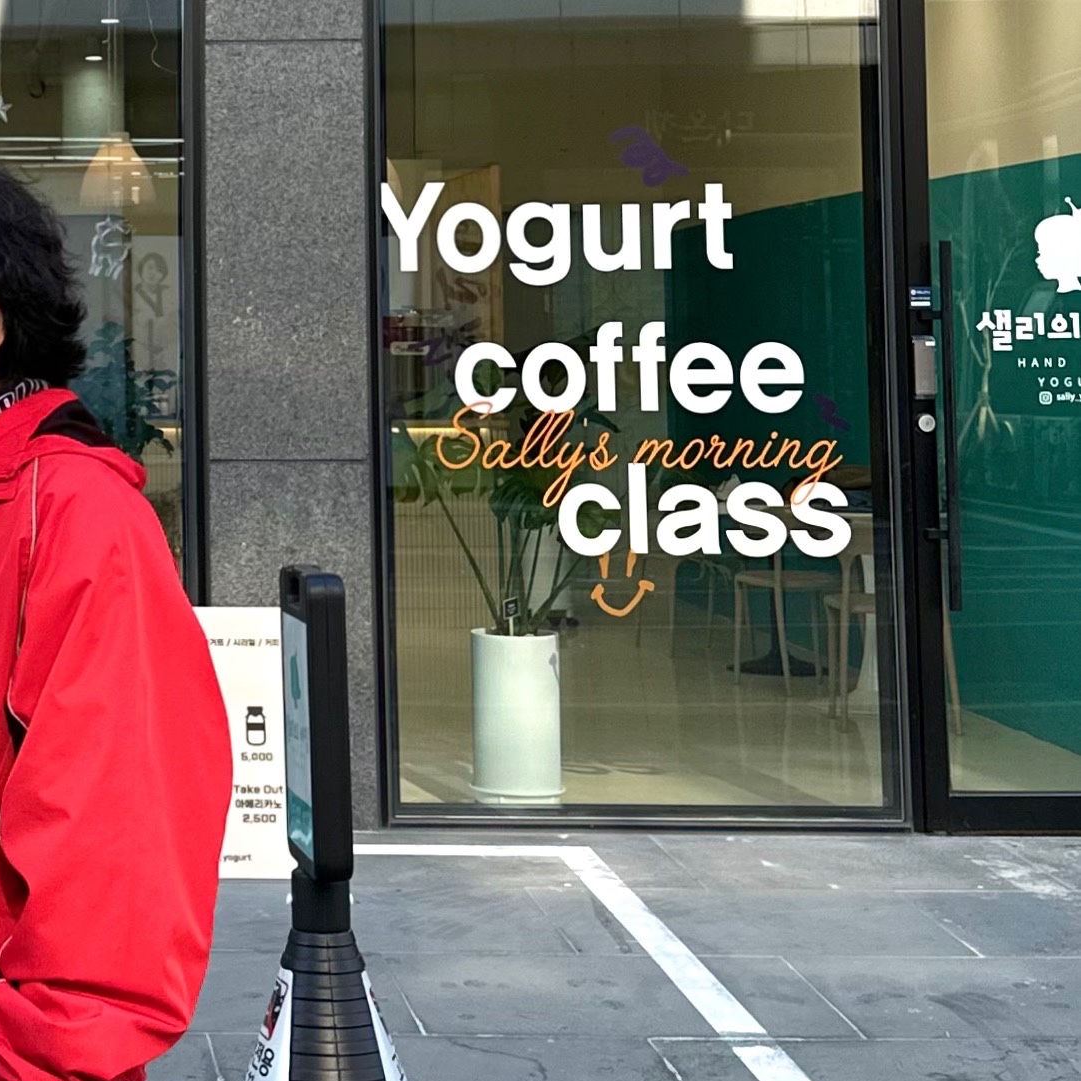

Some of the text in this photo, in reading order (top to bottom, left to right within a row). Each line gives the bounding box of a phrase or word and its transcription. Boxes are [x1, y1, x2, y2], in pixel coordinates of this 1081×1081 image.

[380, 181, 734, 286] Yogurt
[454, 321, 805, 414] coffee
[1017, 357, 1067, 368] HAND
[436, 401, 844, 507] Sally's morning
[558, 462, 852, 558] class
[240, 752, 274, 763] 5,000
[234, 784, 284, 795] Take Out
[235, 799, 283, 809] 아메리카노
[242, 813, 277, 825] 2,500
